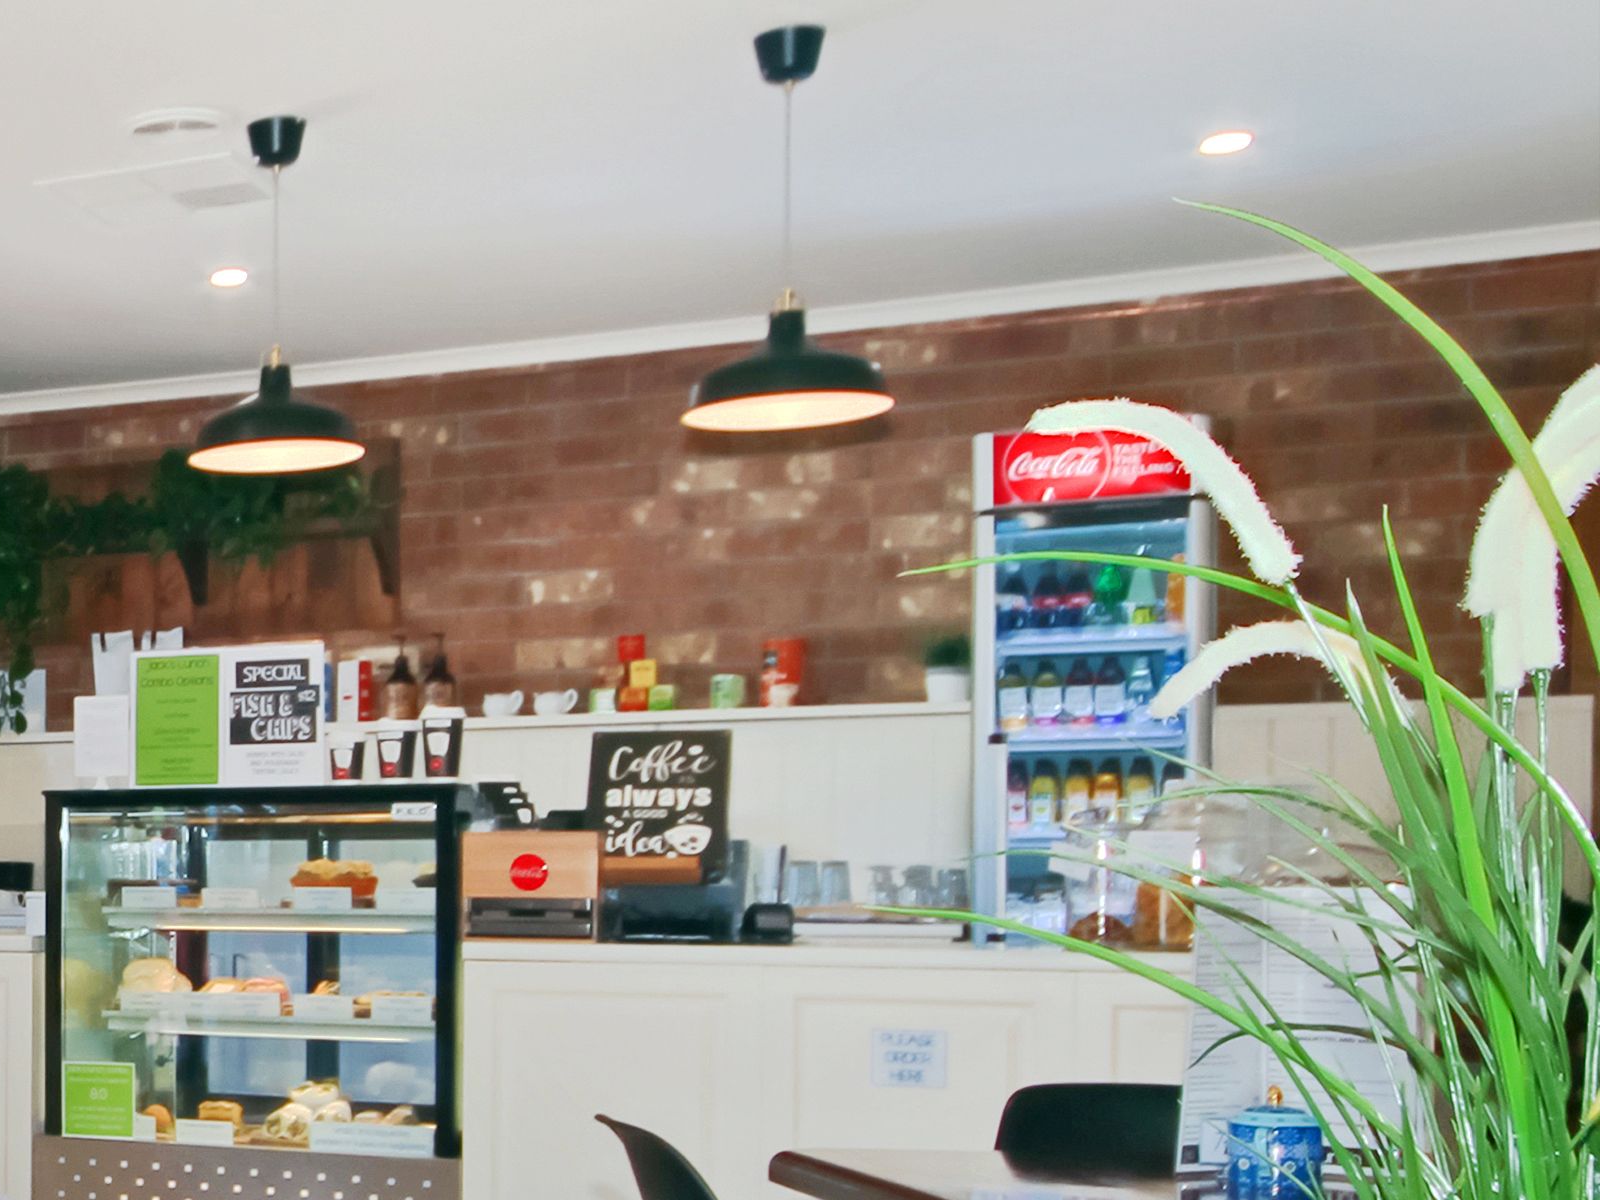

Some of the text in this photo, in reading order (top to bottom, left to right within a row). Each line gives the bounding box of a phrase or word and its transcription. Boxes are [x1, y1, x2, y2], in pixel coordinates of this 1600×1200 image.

[1008, 446, 1103, 481] Coca-Cola
[243, 664, 306, 683] SPECIAL
[231, 692, 274, 718] FISH
[251, 716, 312, 741] CHIPS
[609, 740, 716, 783] Coffee
[605, 784, 712, 811] always
